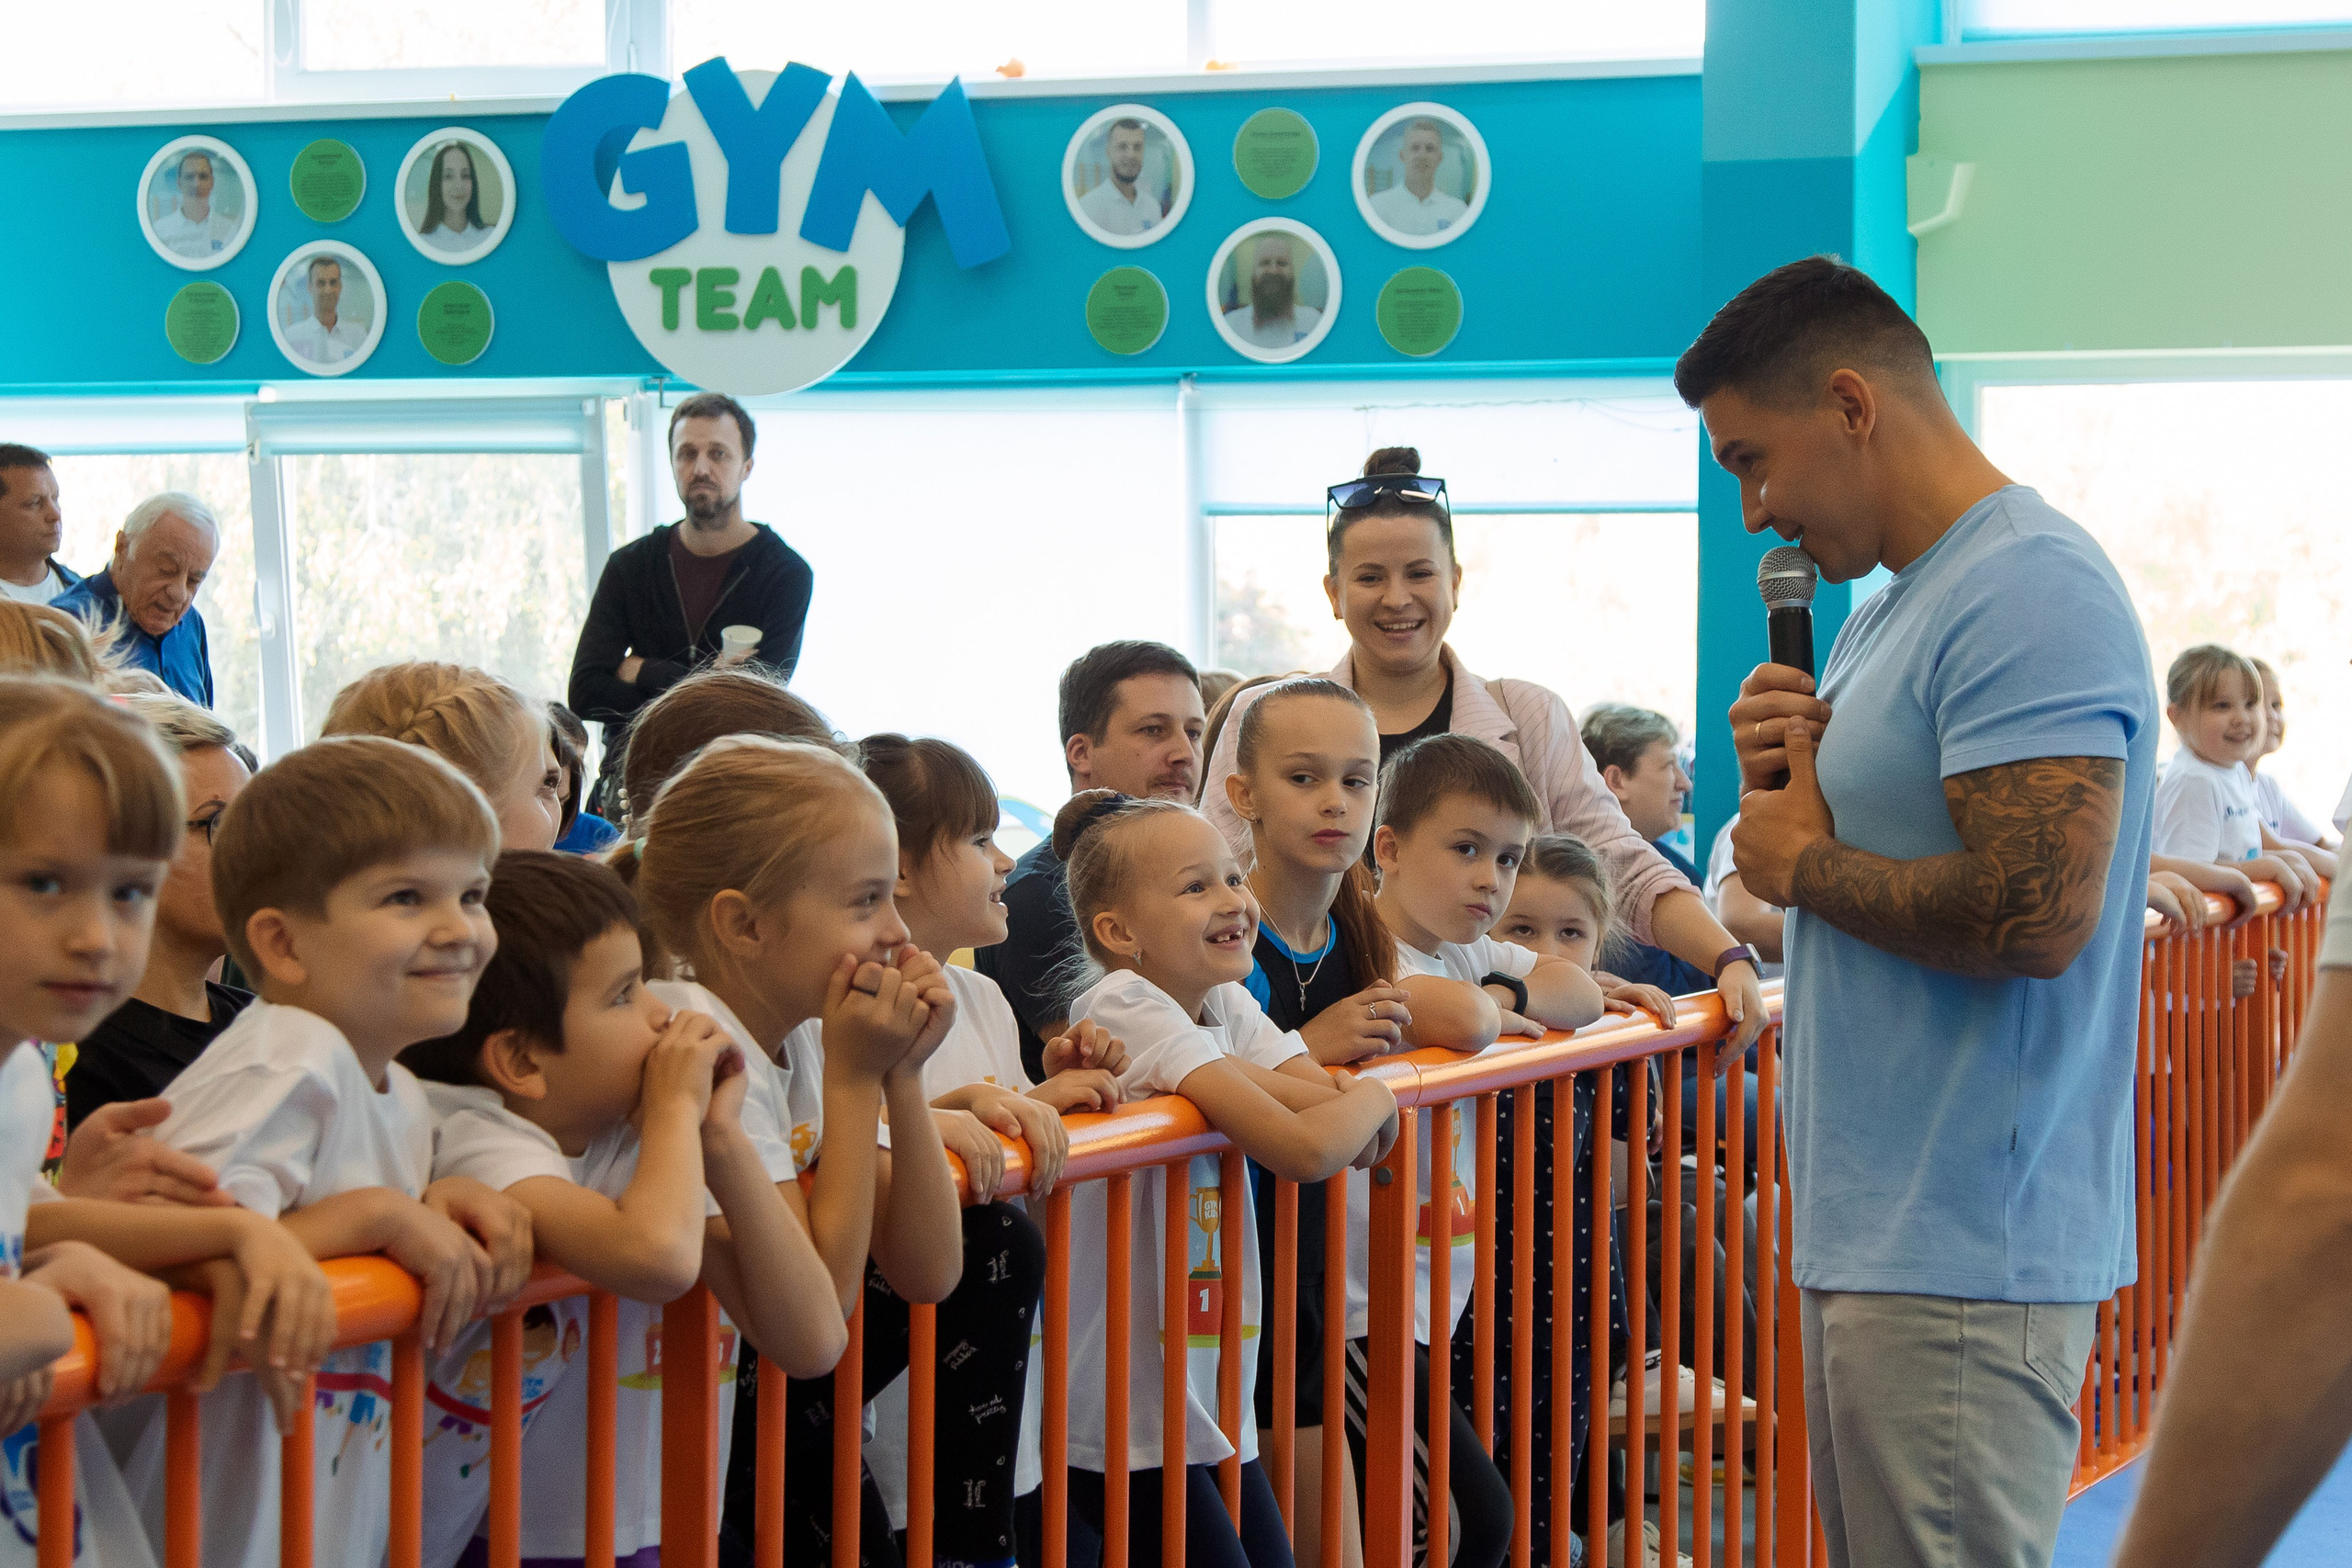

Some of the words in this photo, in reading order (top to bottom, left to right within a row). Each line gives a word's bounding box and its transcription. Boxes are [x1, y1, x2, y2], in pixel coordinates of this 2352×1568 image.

[541, 56, 1011, 270] GYM
[650, 265, 857, 331] TEAM
[1199, 1288, 1209, 1312] 1
